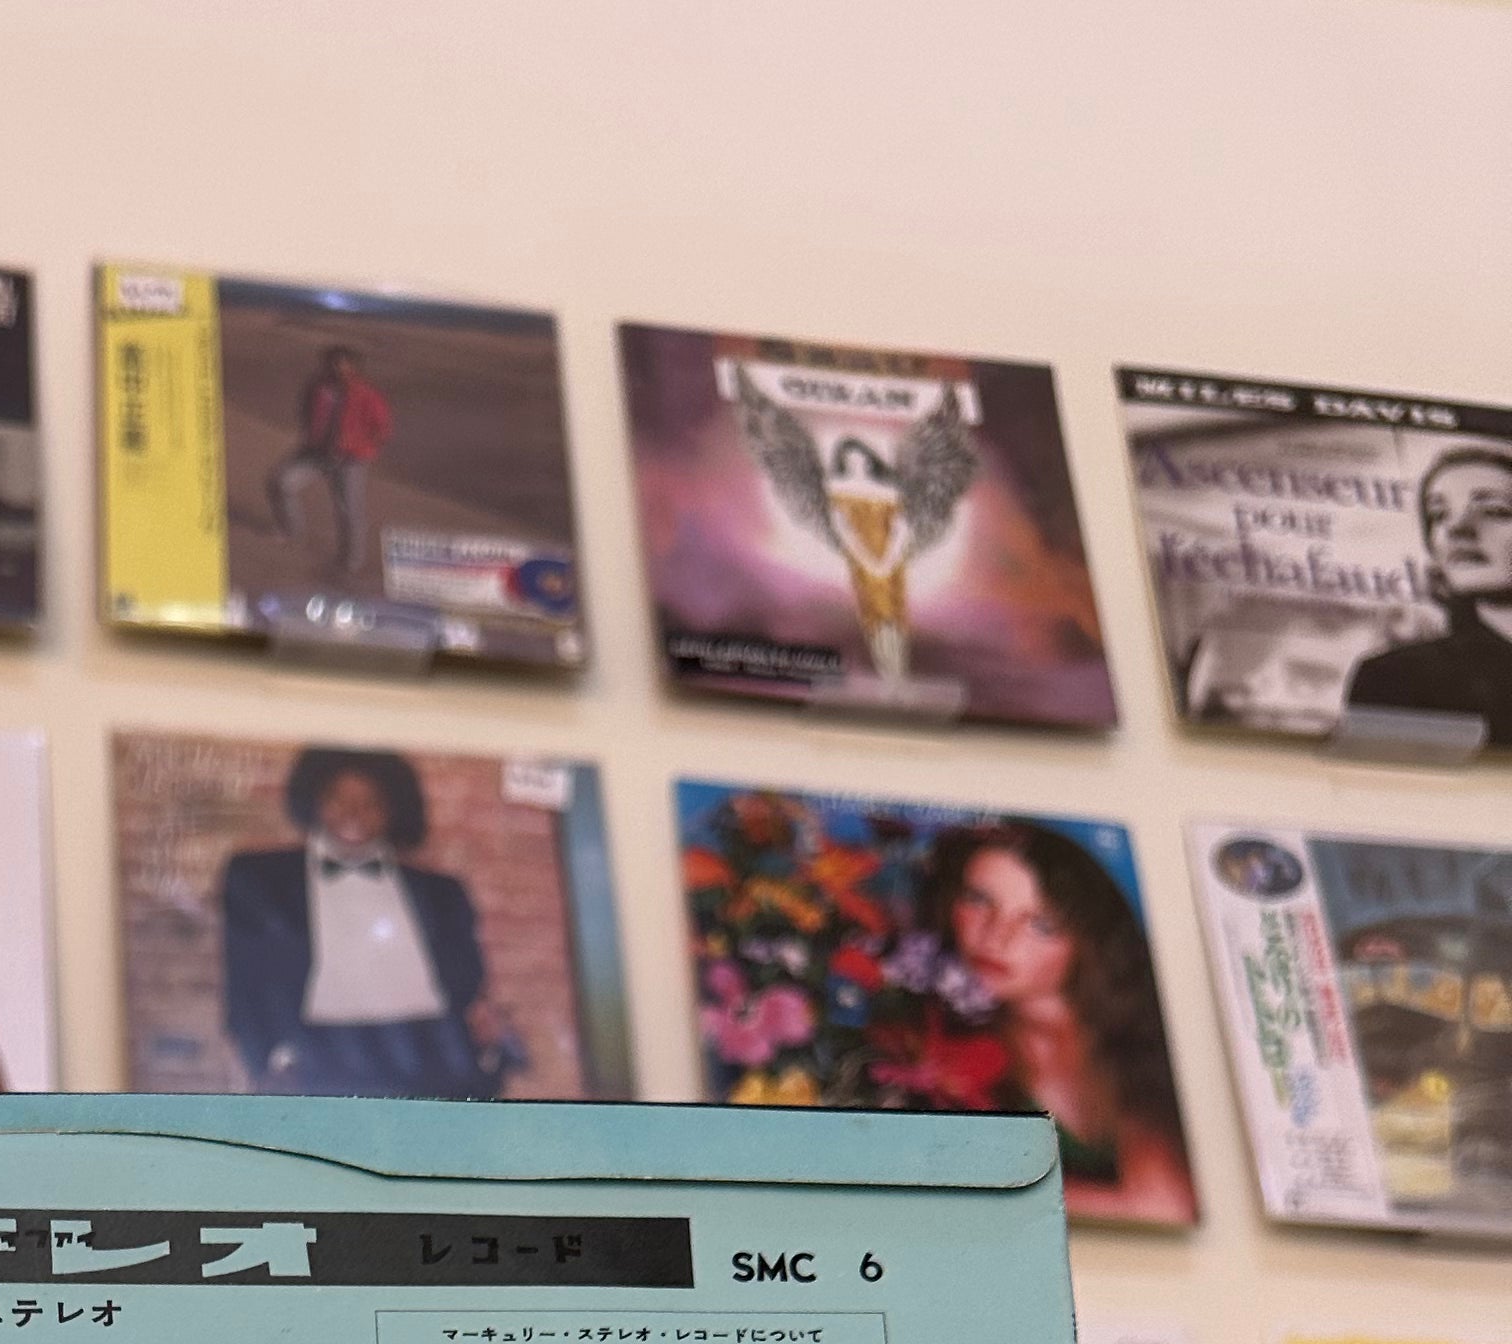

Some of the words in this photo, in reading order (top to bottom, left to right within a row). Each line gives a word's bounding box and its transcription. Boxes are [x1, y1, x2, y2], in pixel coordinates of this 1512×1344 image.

[1312, 392, 1461, 431] DAVIS
[420, 1232, 583, 1265] レコード
[732, 1252, 817, 1283] SMC
[859, 1252, 883, 1282] 6
[442, 1327, 823, 1343] マーキュリー・ステレオ・レコードについて
